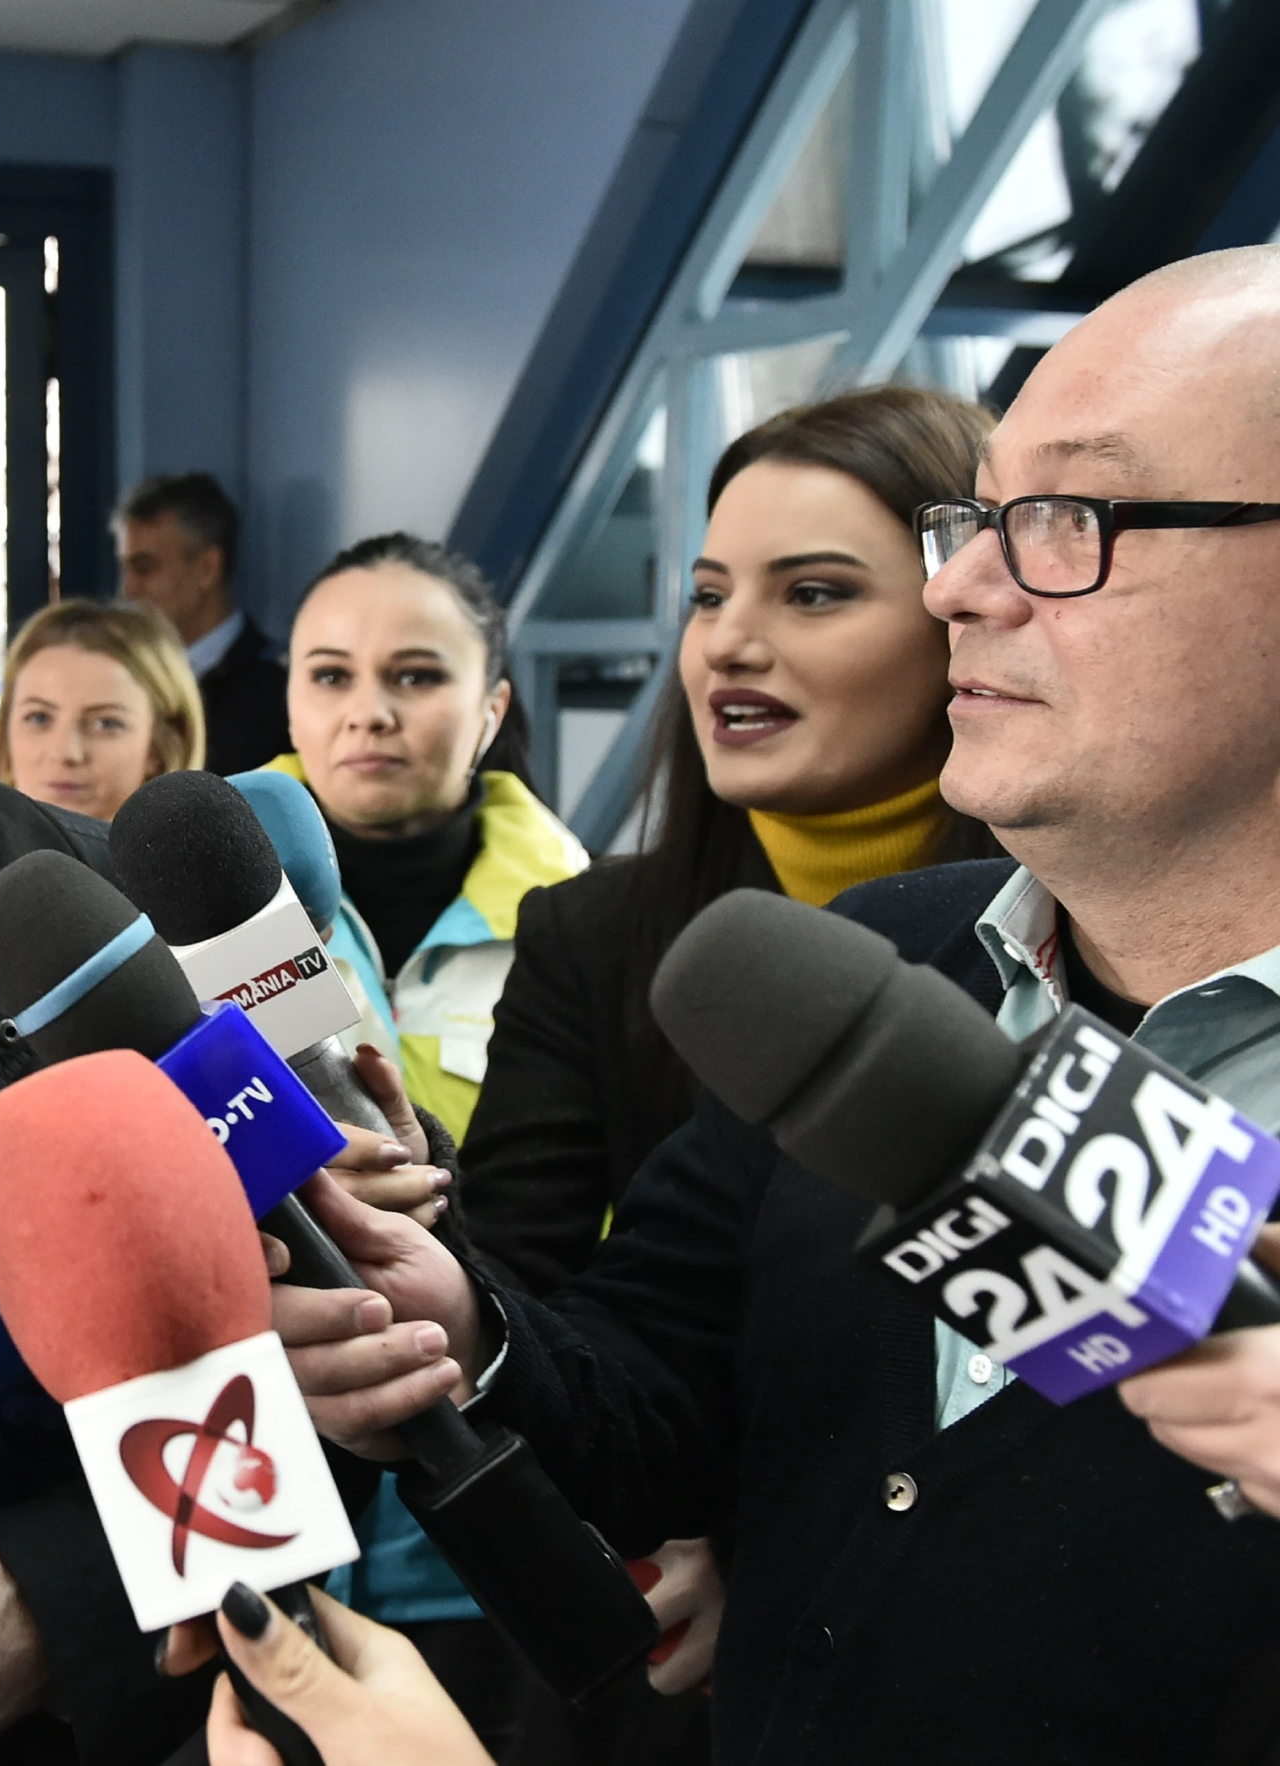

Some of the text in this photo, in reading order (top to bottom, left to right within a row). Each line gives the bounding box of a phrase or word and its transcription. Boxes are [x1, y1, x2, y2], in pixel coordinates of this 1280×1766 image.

[298, 951, 322, 974] TV
[1001, 1025, 1121, 1191] DIGI
[1064, 1071, 1255, 1298] 24
[1191, 1185, 1251, 1257] HD
[881, 1196, 1013, 1284] DIGI
[941, 1244, 1150, 1364] 24
[1067, 1333, 1132, 1375] HD
